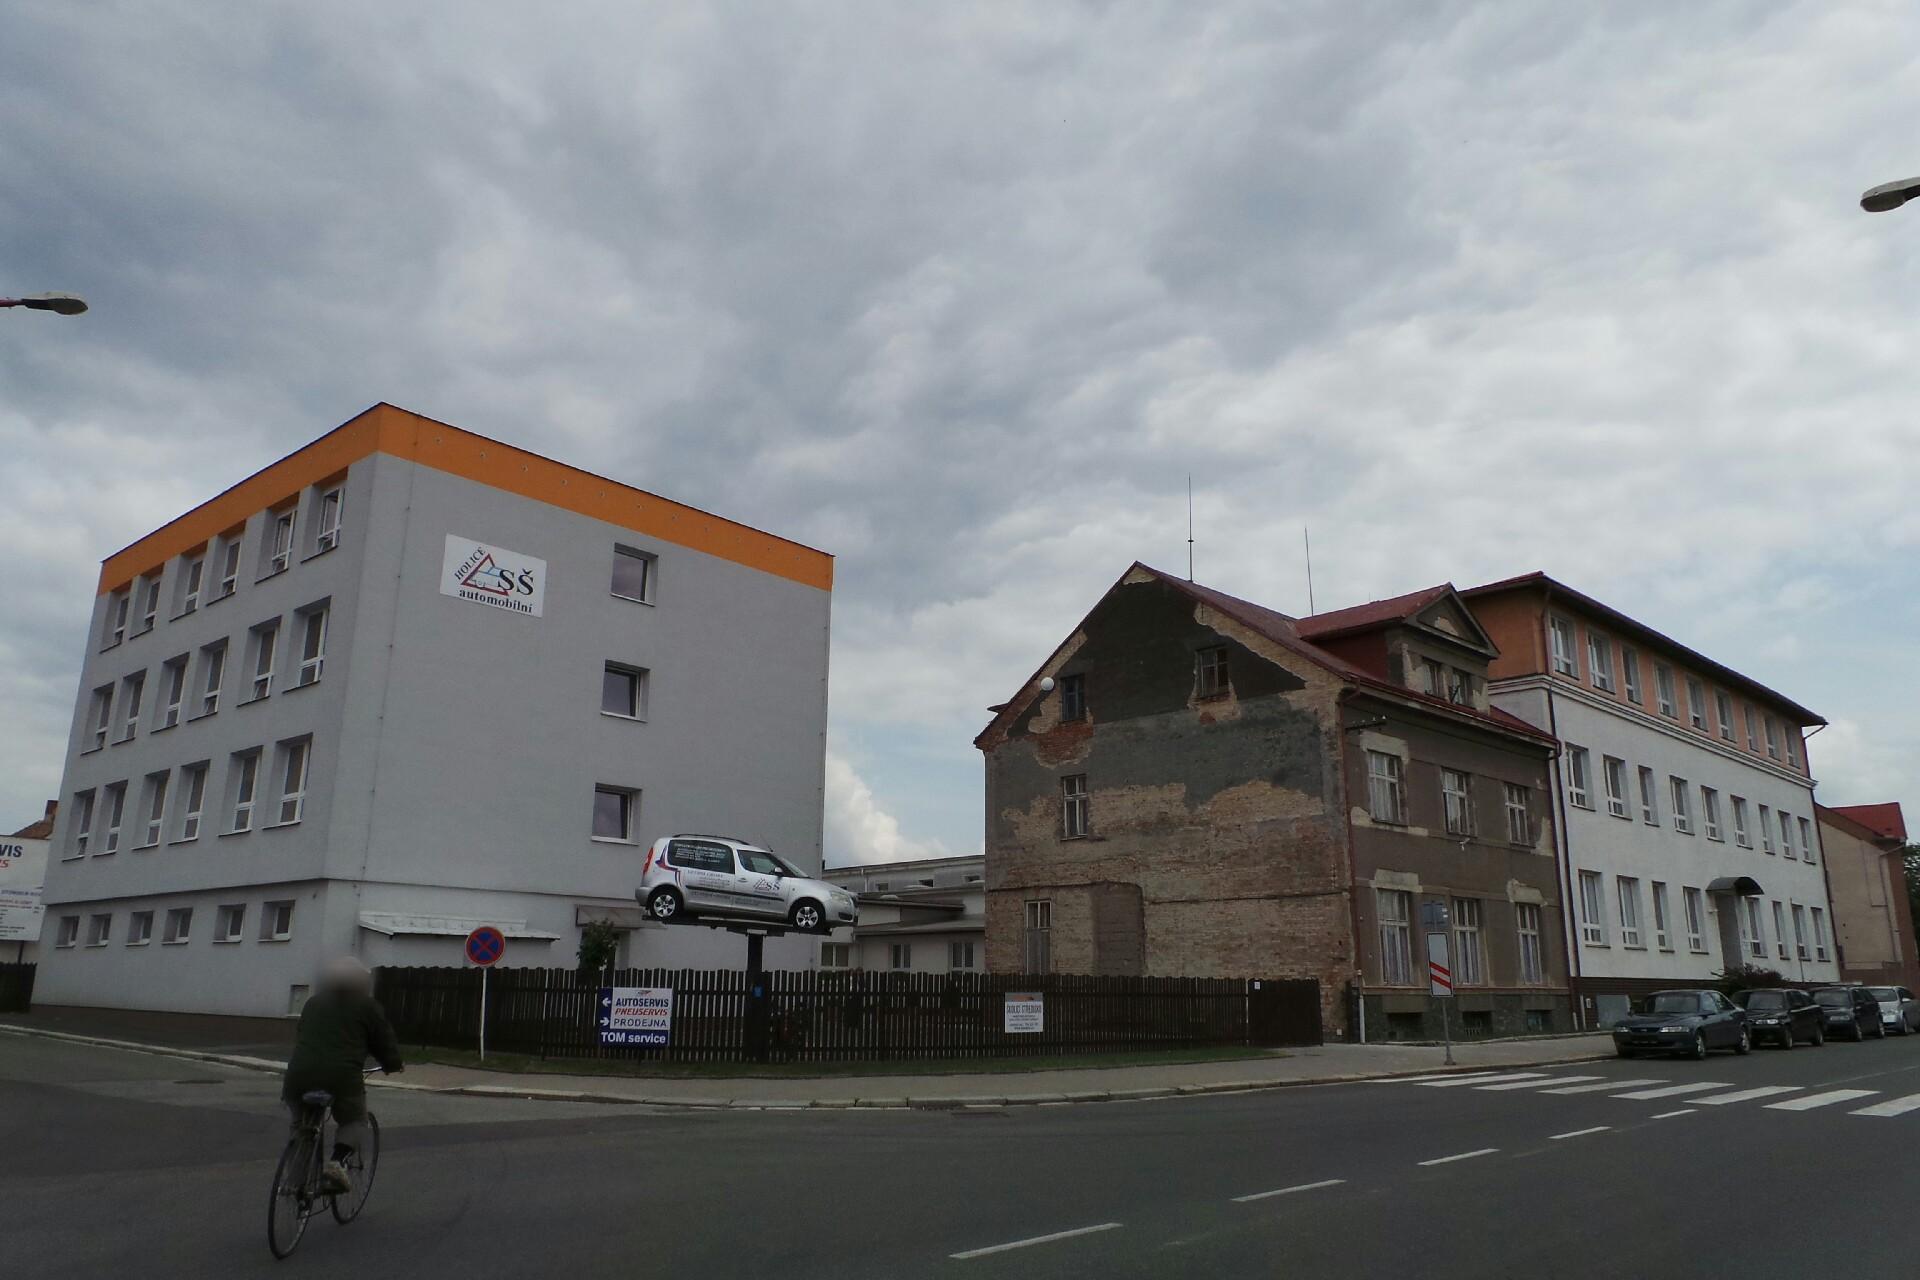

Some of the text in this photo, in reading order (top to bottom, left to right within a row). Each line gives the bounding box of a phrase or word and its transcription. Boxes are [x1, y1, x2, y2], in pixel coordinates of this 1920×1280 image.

[454, 546, 486, 580] HOLICE
[498, 568, 534, 596] SŠ
[459, 589, 533, 613] automobilní
[616, 998, 669, 1008] AUTOSERVIS
[615, 1008, 668, 1016] PNEUSERVIS
[613, 1018, 667, 1027] PRODEJNA
[601, 1032, 666, 1043] TOM service
